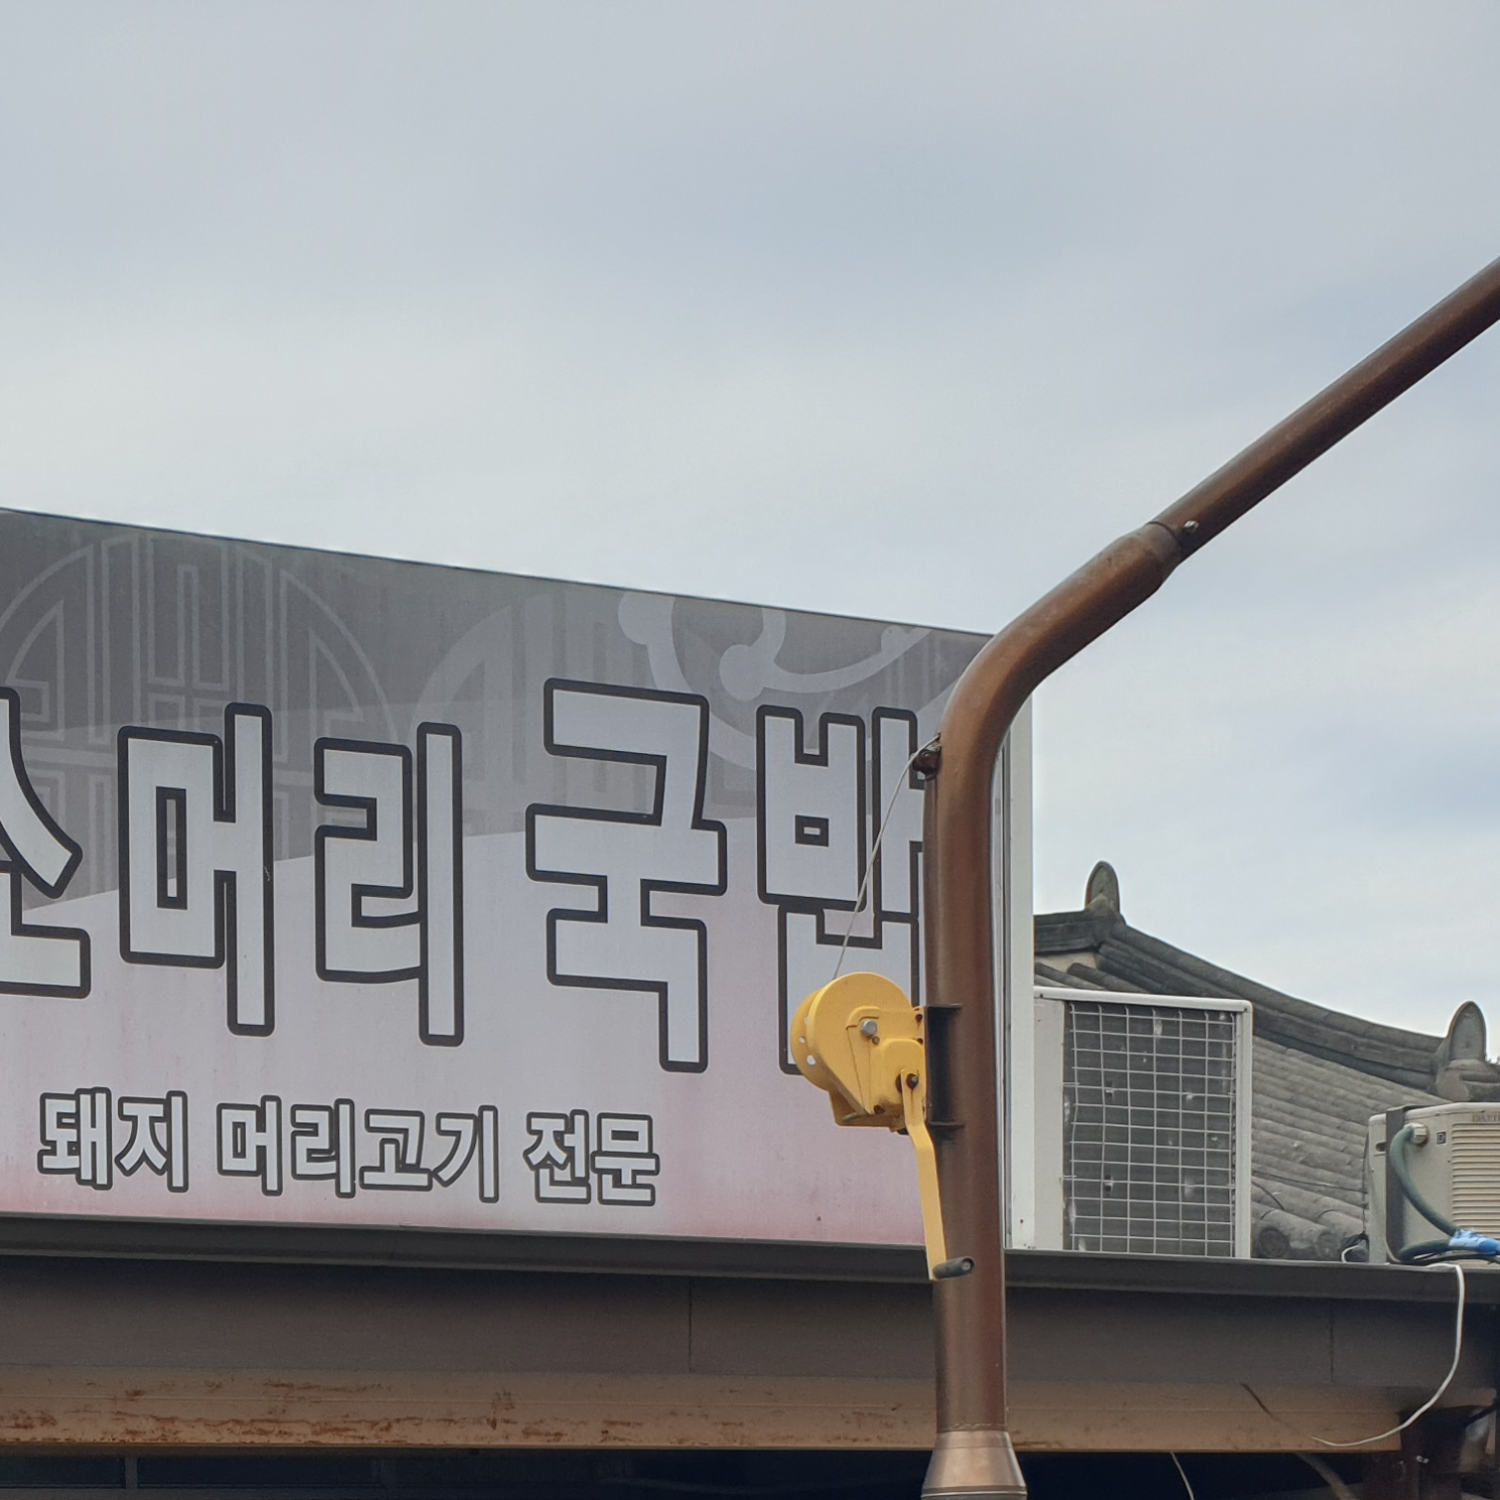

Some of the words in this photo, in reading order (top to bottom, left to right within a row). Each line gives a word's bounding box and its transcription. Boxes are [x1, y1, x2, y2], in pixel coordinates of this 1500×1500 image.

[38, 1086, 189, 1192] 돼지
[216, 1095, 500, 1203] 머리고기
[523, 1110, 660, 1206] 전문
